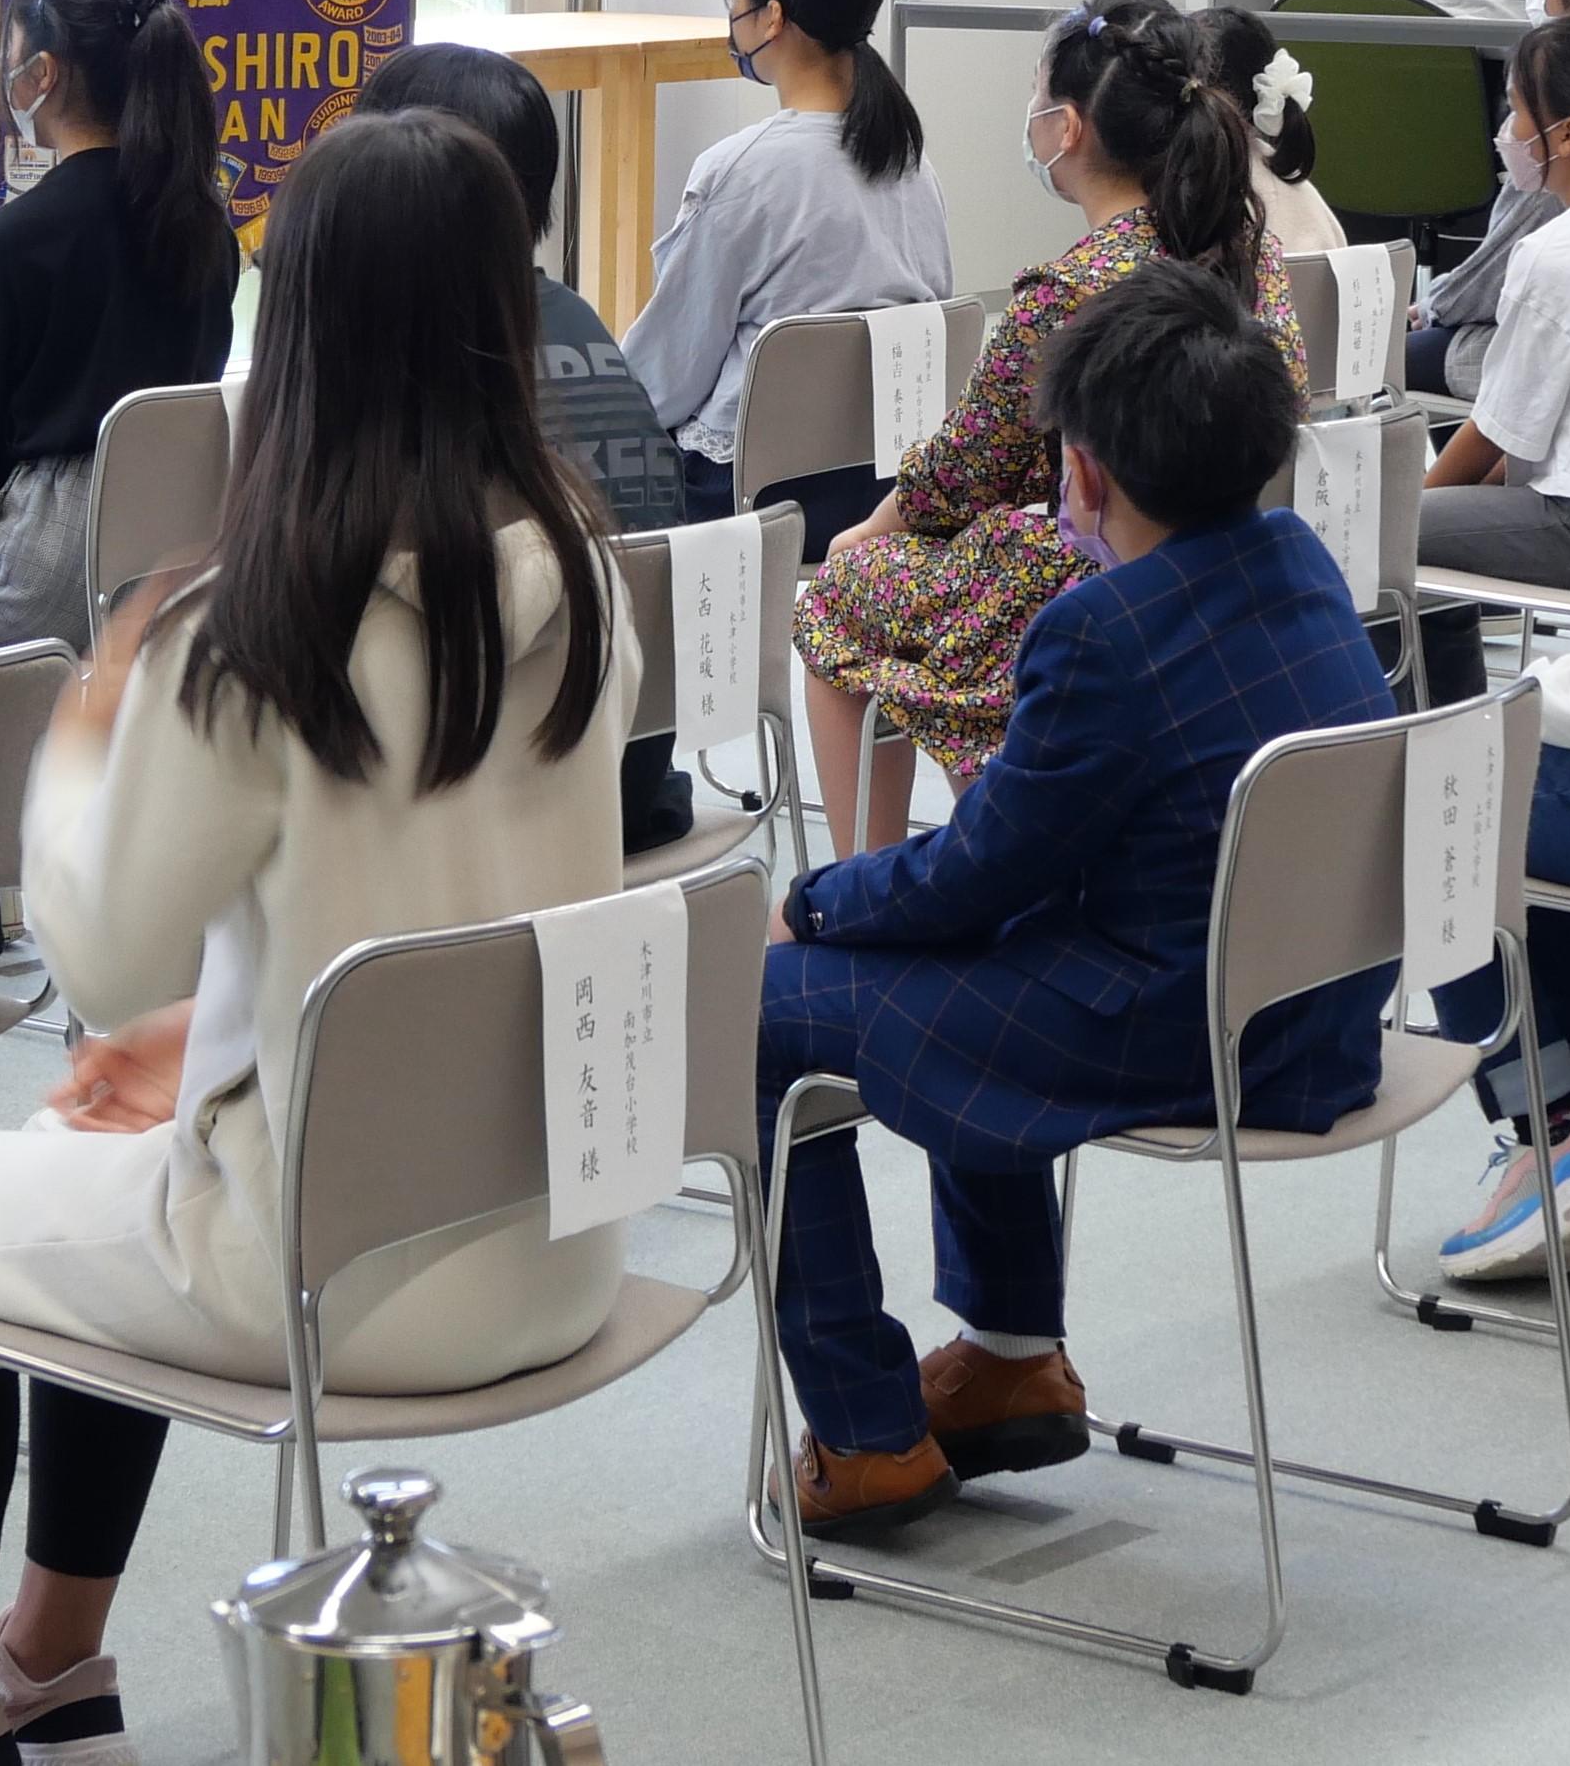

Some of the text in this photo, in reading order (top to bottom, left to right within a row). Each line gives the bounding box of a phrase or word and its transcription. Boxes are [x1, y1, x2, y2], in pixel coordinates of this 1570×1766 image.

[318, 0, 364, 20] AWARD
[203, 30, 359, 92] SHIRO
[220, 98, 286, 144] AN
[698, 572, 713, 618] 大西
[640, 940, 654, 1044] 木津川市立
[575, 976, 600, 1182] 岡西 友音 様
